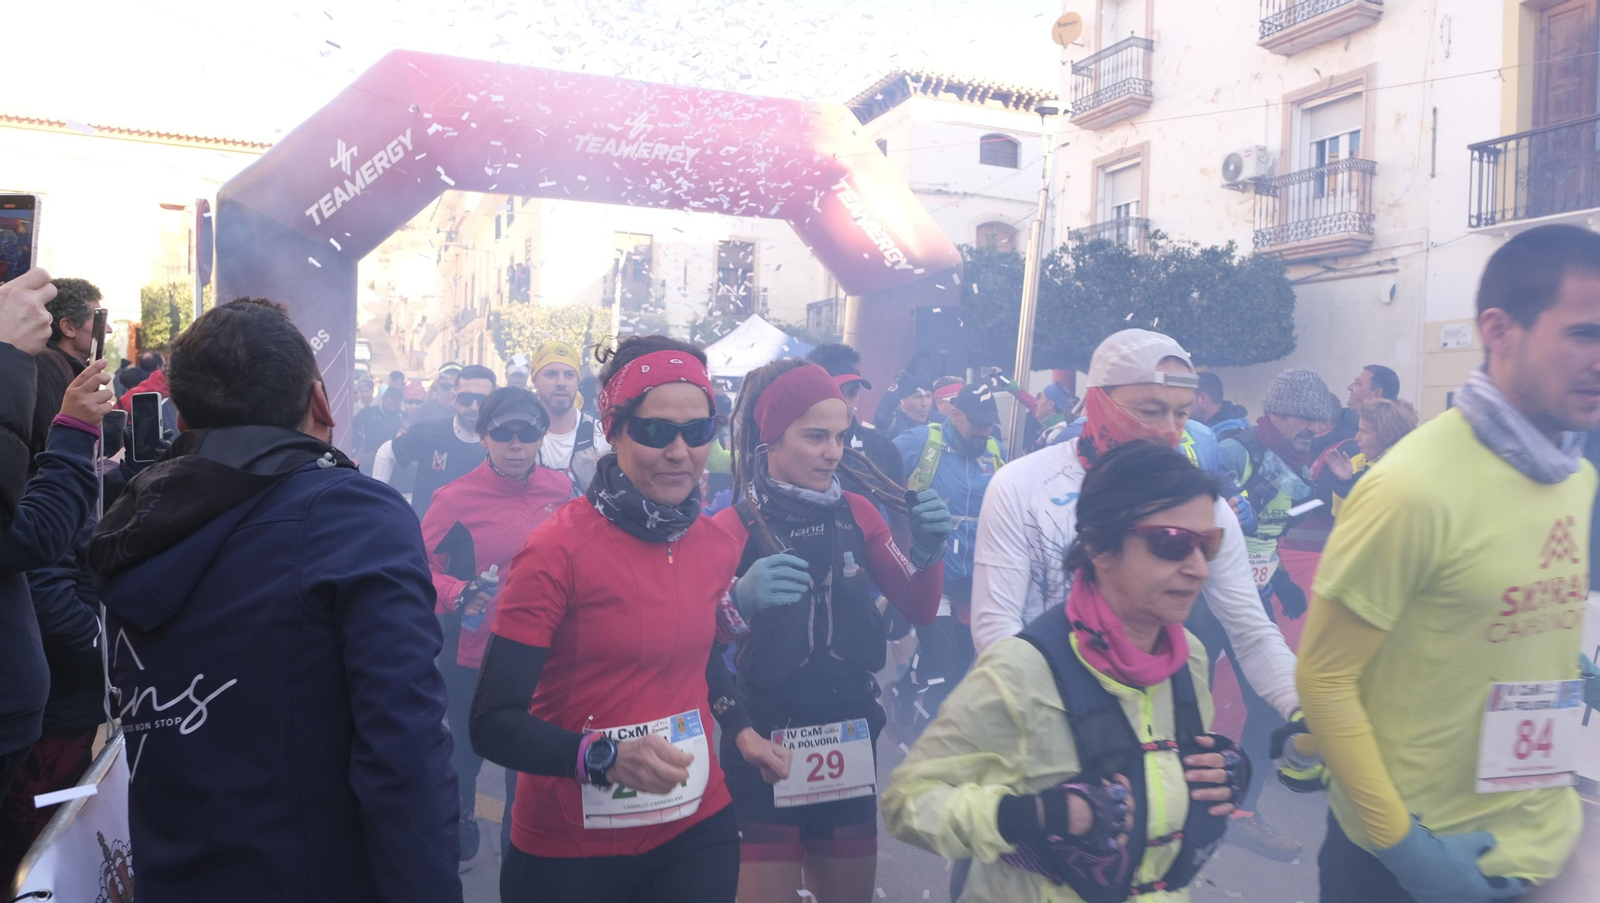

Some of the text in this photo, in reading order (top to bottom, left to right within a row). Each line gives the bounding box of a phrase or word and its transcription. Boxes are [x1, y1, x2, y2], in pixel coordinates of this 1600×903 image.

[574, 133, 702, 171] TEAMERGY
[304, 127, 414, 227] TEAMERGY
[831, 174, 915, 270] TEAMERGY
[310, 328, 331, 355] es
[134, 721, 152, 732] NON
[154, 716, 182, 729] STOP
[617, 724, 649, 741] CxM
[786, 730, 798, 740] IV
[800, 726, 823, 739] CxM
[1511, 718, 1555, 760] 84
[806, 749, 845, 783] 29
